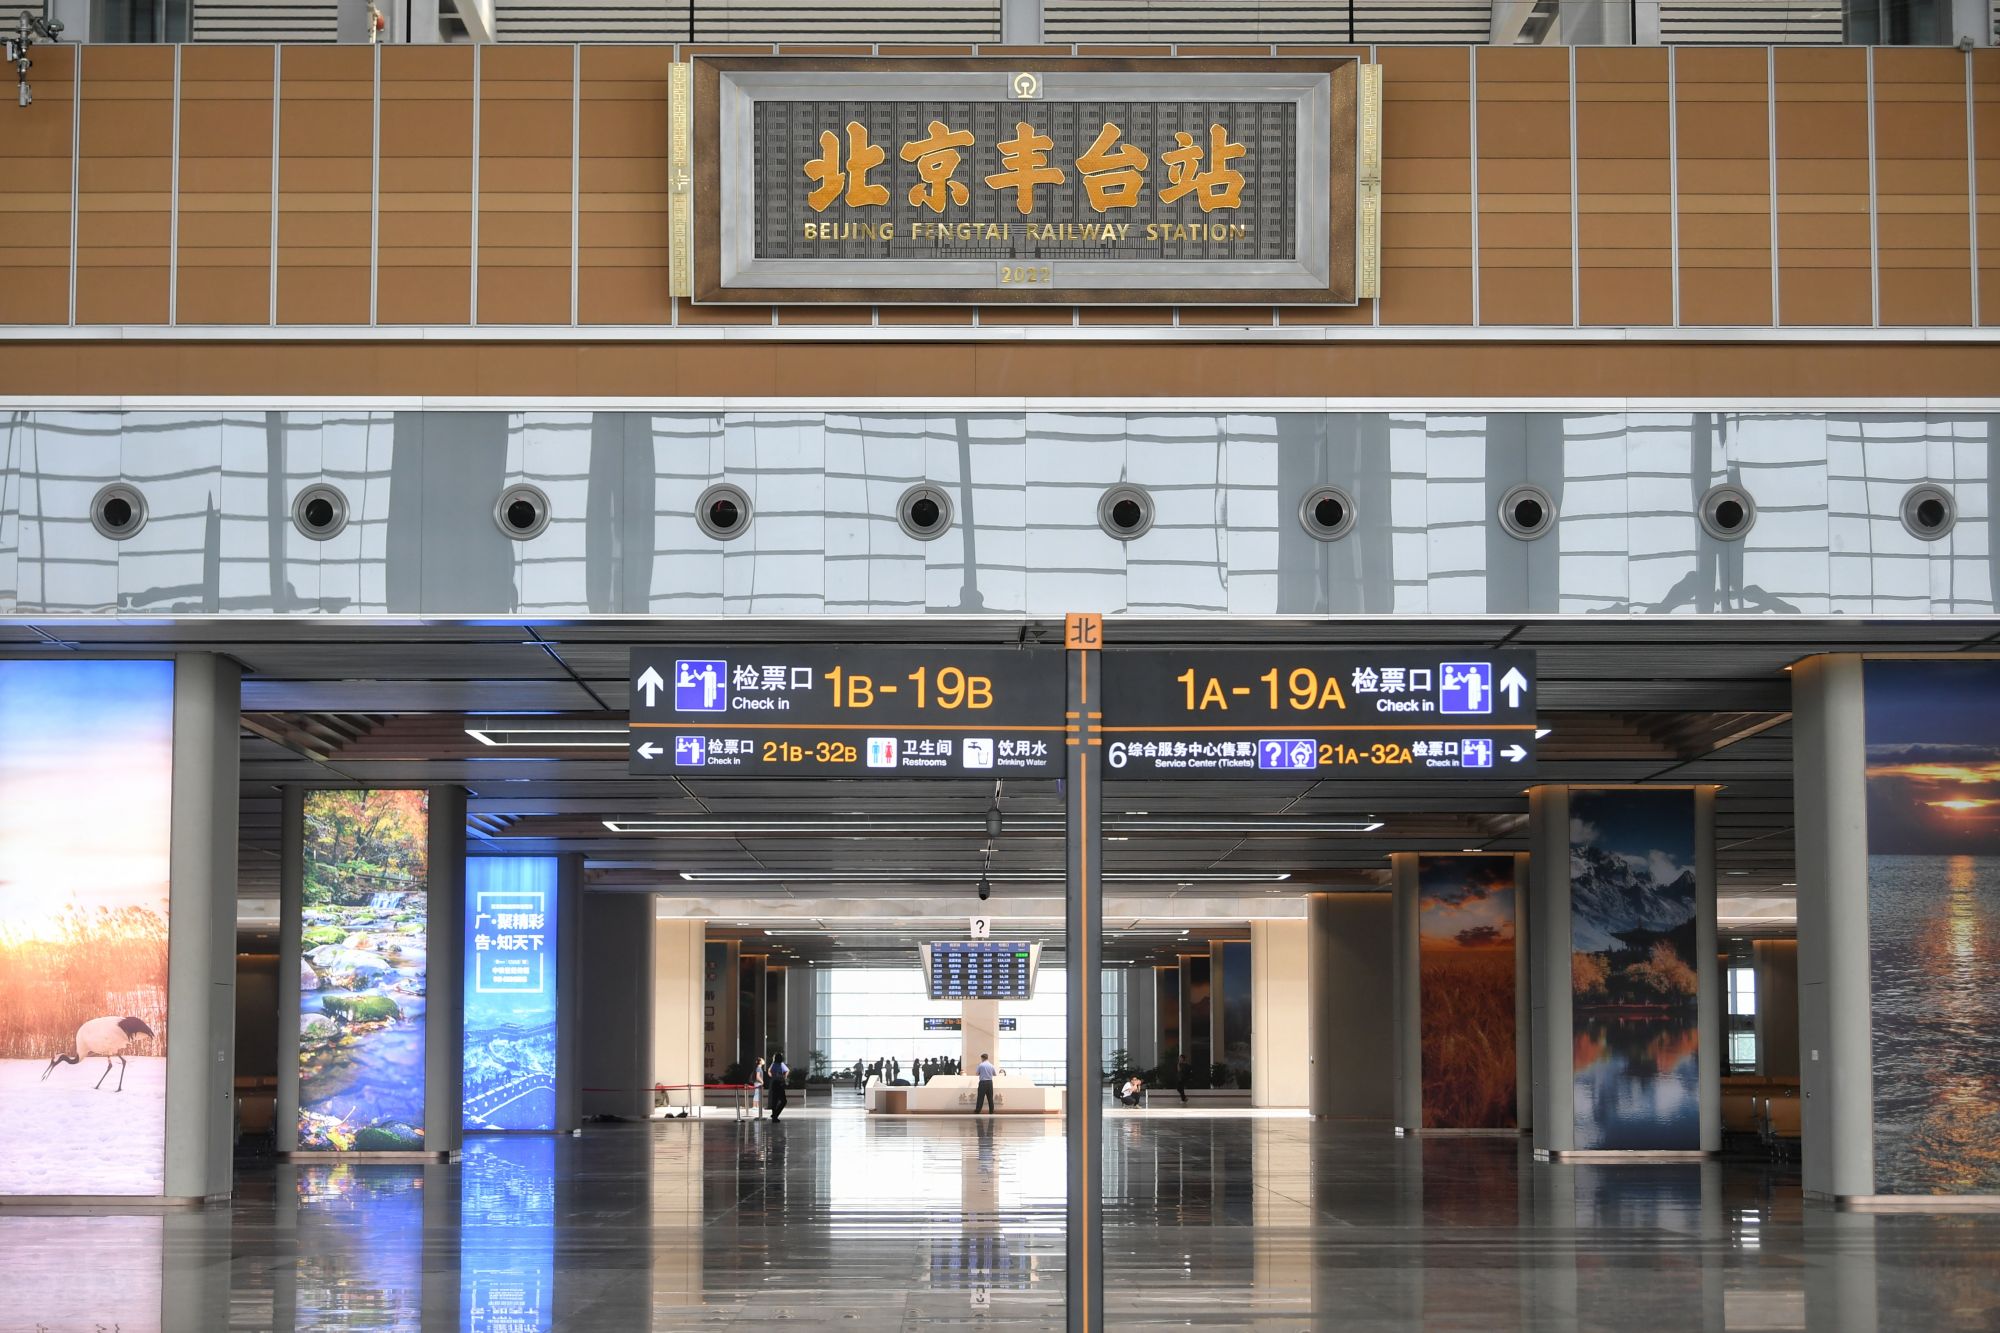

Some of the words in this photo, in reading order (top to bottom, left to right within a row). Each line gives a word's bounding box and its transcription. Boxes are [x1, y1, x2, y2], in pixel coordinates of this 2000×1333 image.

[805, 121, 1245, 213] 北京丰台站
[803, 220, 894, 241] BEIJING
[912, 221, 1009, 241] FENGTAI
[1026, 221, 1130, 241] RAILWAY
[1145, 223, 1246, 243] STATION
[1000, 267, 1051, 284] 2022
[1071, 618, 1097, 644] 北
[733, 665, 812, 691] 检票口
[1352, 667, 1431, 693] 检票口
[732, 697, 775, 710] Check
[777, 697, 790, 710] in
[1376, 699, 1419, 712] Check
[1422, 699, 1435, 712] in
[708, 739, 754, 755] 检票口
[763, 742, 857, 762] 21B-32B
[902, 739, 952, 756] 卫生间
[998, 740, 1047, 756] 饮用水
[1108, 742, 1127, 768] 6
[1412, 741, 1459, 756] 检票口
[707, 757, 731, 766] Check
[732, 757, 741, 766] in
[902, 758, 948, 767] Restrooms
[997, 757, 1024, 768] Drinking
[1025, 758, 1048, 767] Water
[1155, 759, 1187, 767] Service
[1188, 759, 1217, 767] Center
[1218, 759, 1254, 768] (Tickets)
[1426, 759, 1448, 767] Check
[1450, 759, 1460, 767] in
